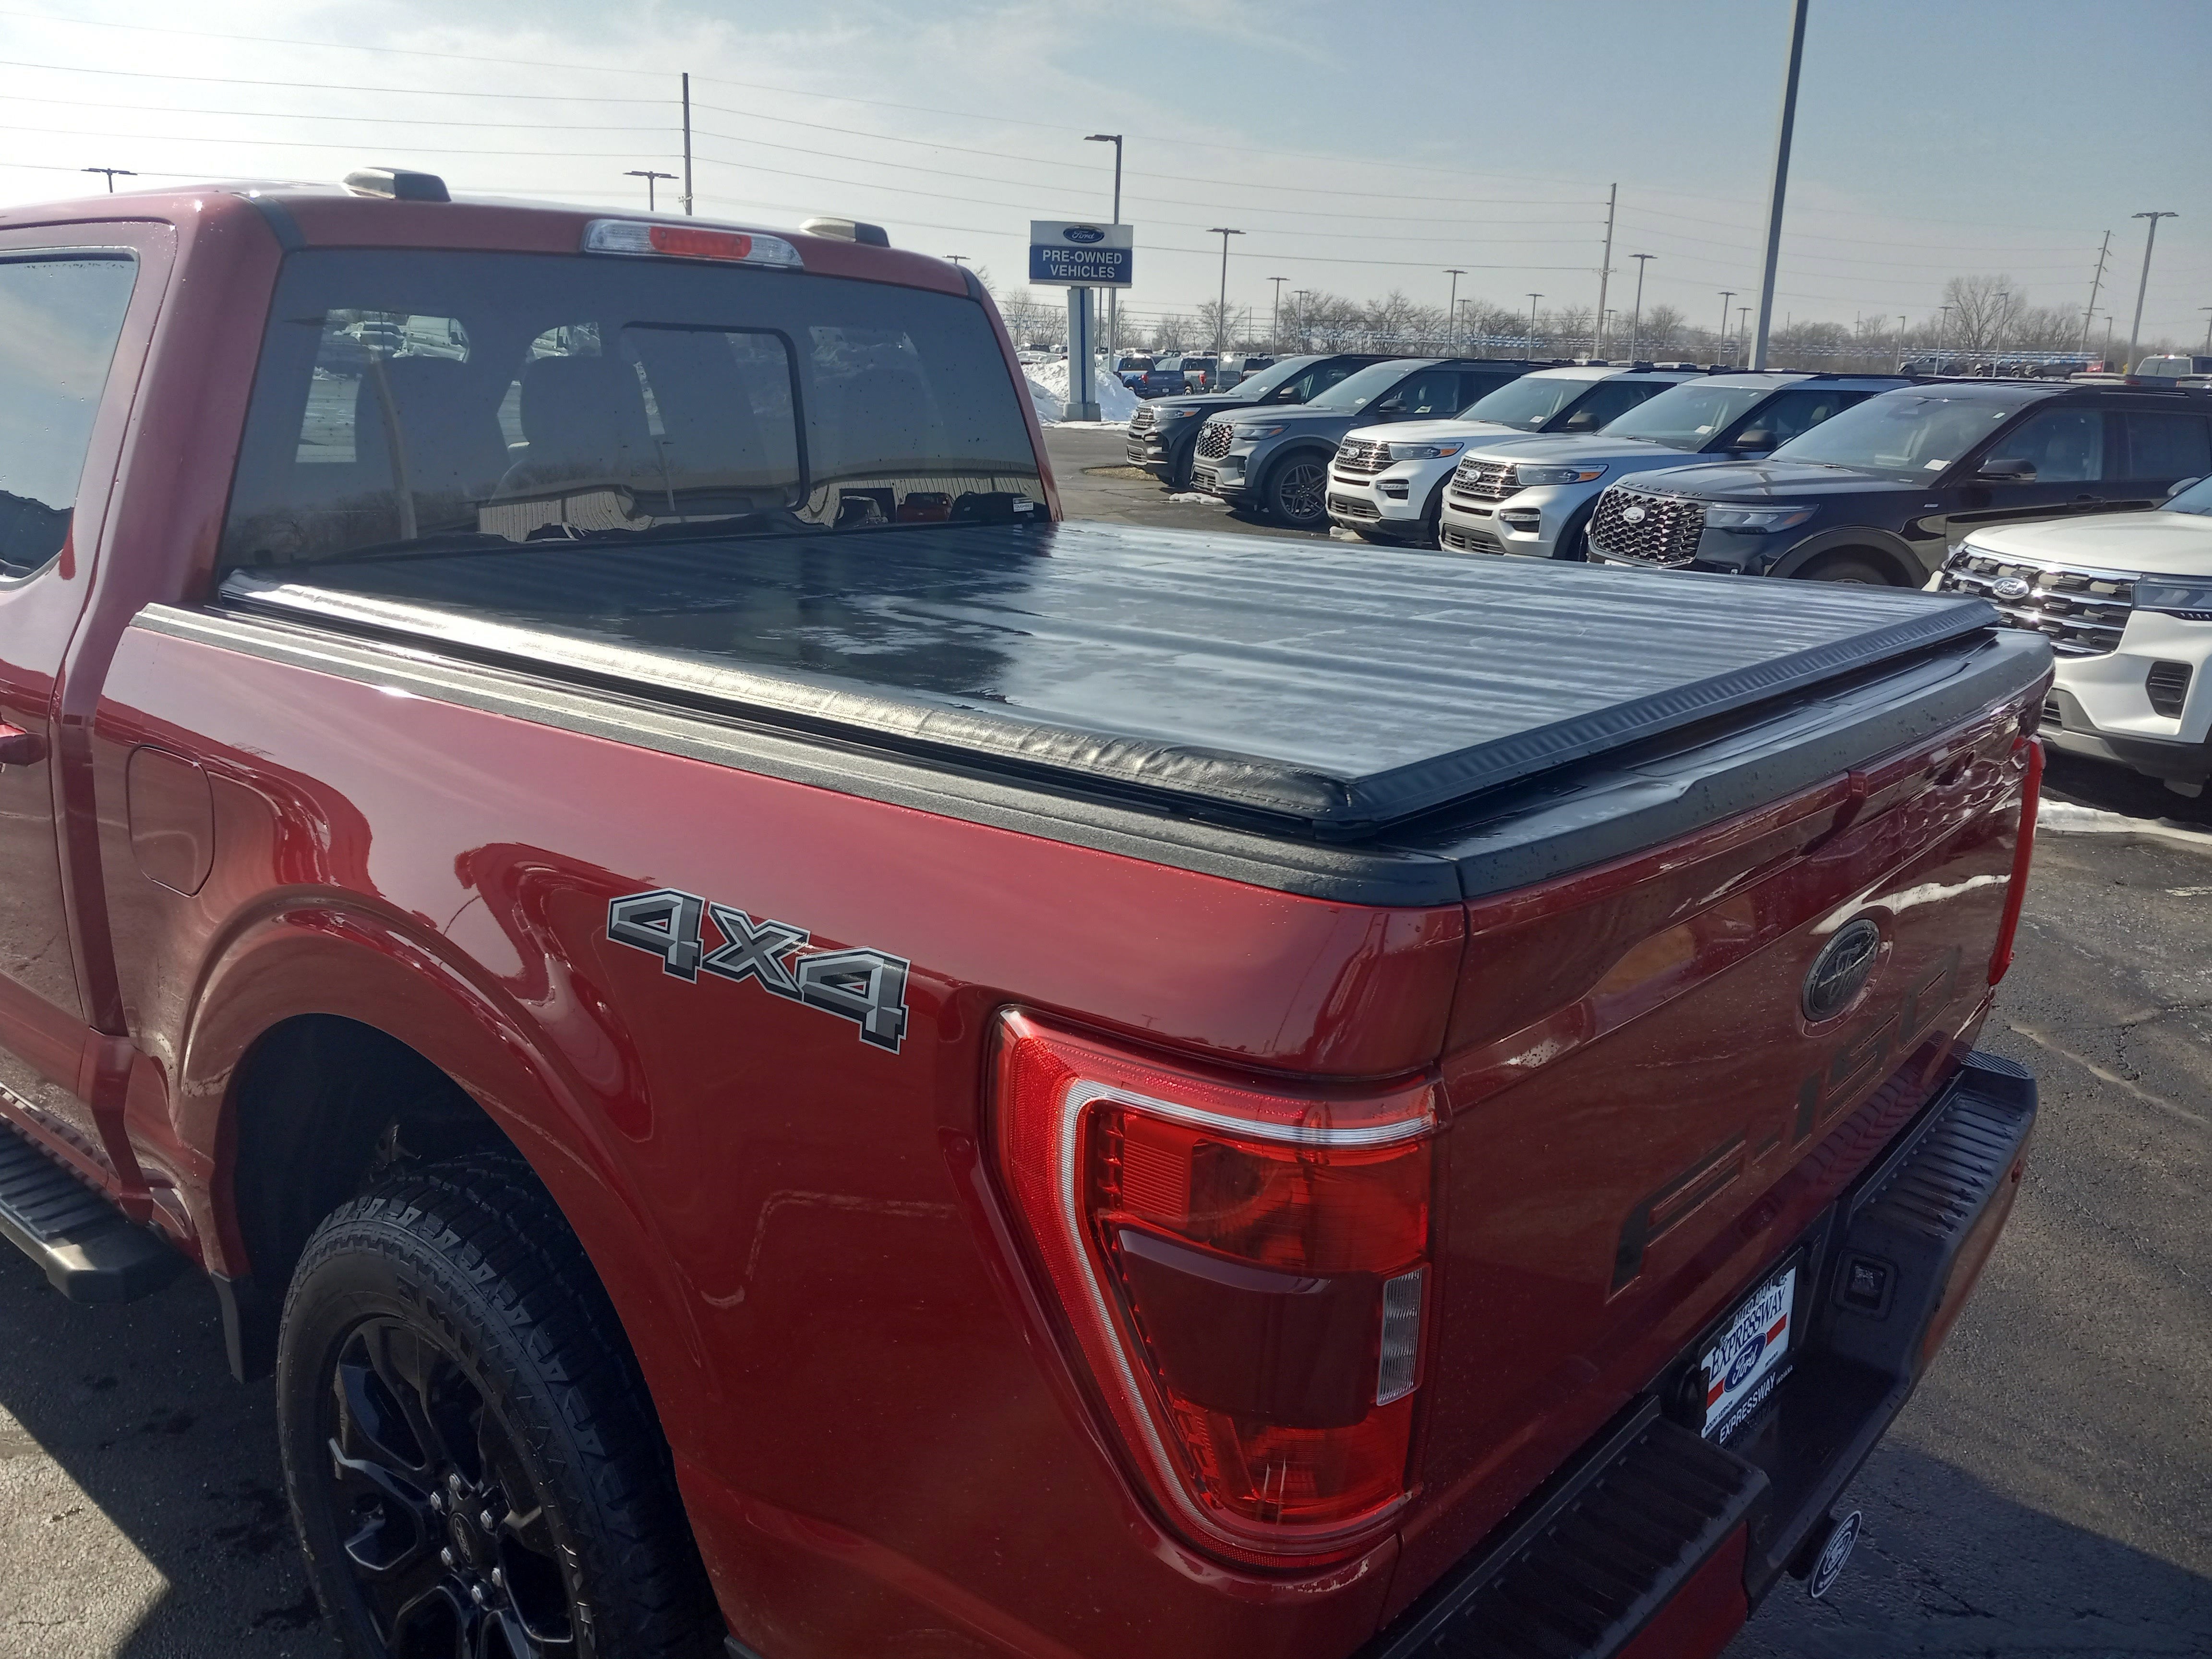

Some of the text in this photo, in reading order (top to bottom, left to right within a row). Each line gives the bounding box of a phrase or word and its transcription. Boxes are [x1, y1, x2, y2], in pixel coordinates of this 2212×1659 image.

[1072, 231, 1095, 240] Ford
[1042, 250, 1122, 264] PRE-OWNED
[1050, 264, 1115, 278] VEHICLES
[1606, 943, 1962, 1304] F-150
[1710, 1286, 1786, 1382] EXPRESSWAY
[1732, 1344, 1759, 1385] Ford
[1719, 1371, 1776, 1445] EXPRESSWAY
